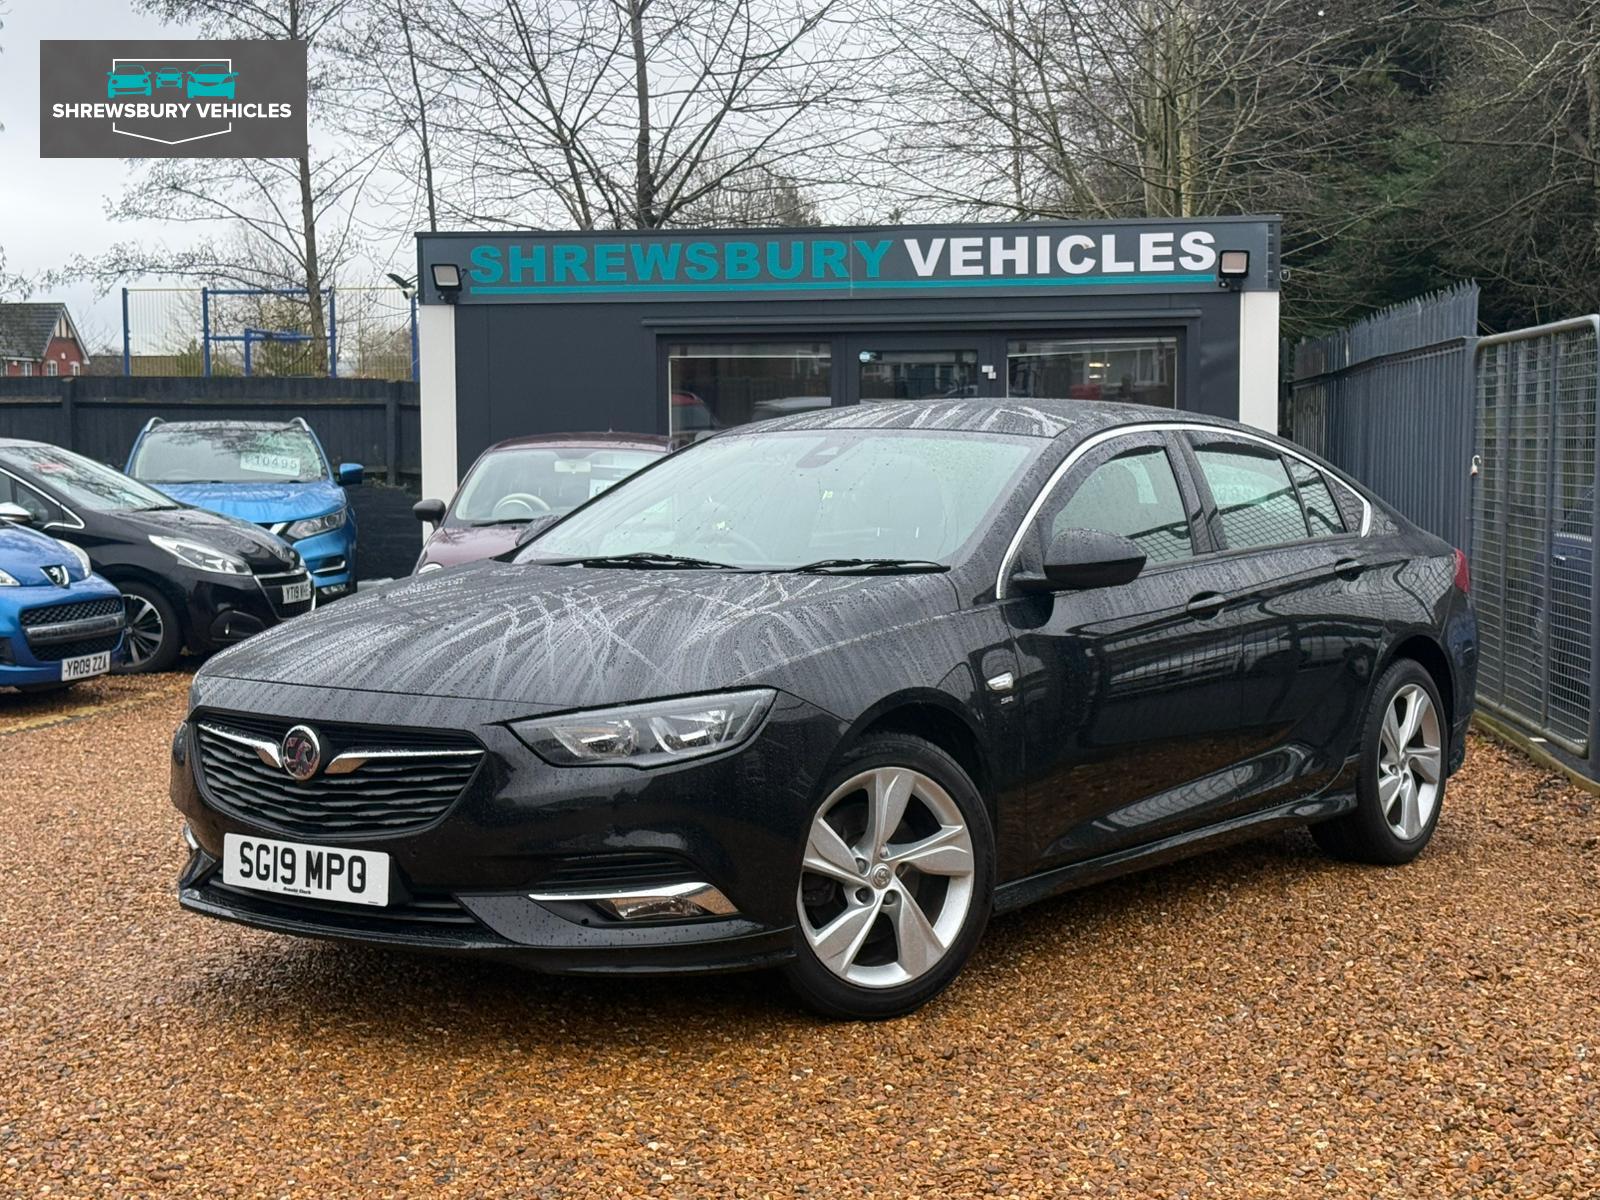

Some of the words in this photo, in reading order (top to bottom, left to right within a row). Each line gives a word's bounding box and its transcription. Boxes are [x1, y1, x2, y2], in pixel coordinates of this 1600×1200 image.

[470, 240, 893, 283] SHREWSBURY
[904, 231, 1216, 276] VEHICLES
[67, 659, 91, 676] YR09
[92, 654, 107, 672] ZZA
[239, 841, 297, 886] SG19
